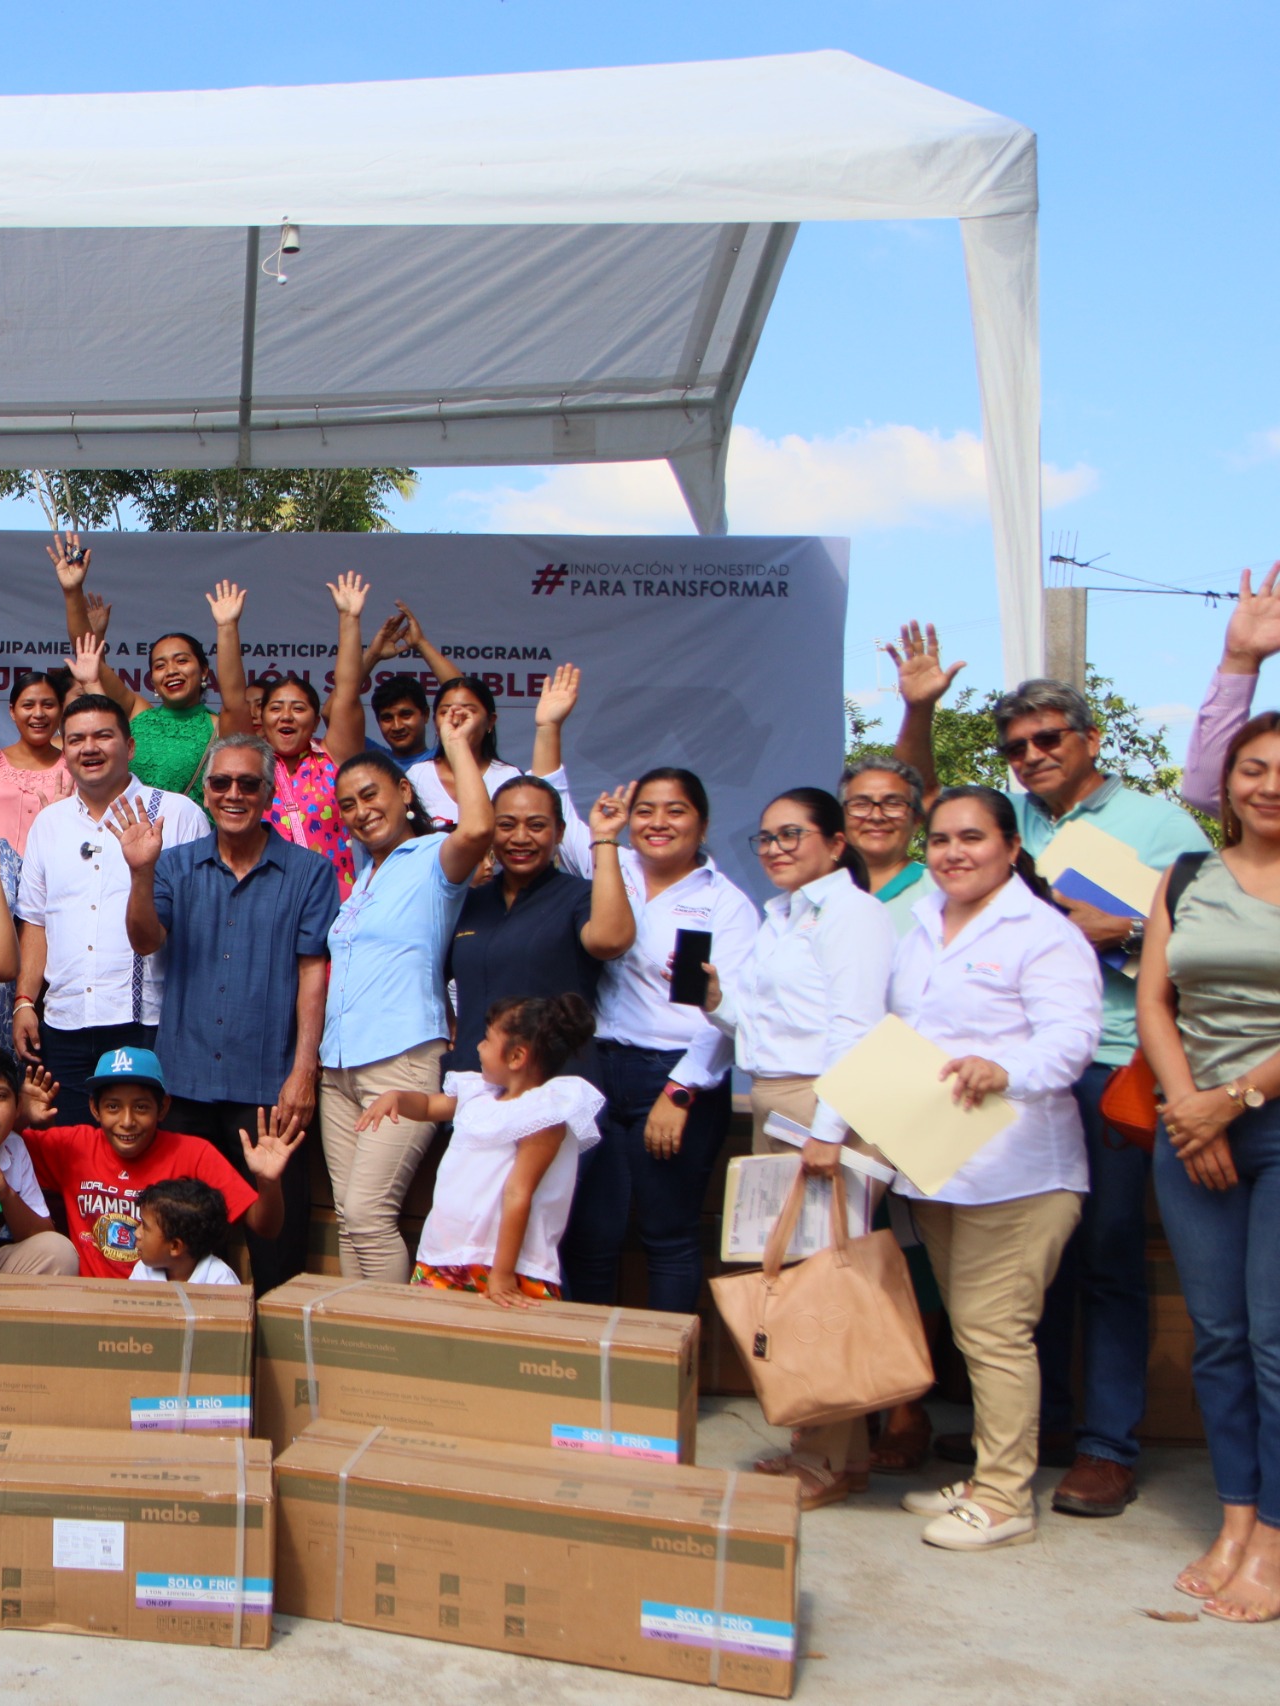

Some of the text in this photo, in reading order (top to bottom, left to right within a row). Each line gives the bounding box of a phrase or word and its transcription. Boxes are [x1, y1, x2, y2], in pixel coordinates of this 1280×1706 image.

[571, 561, 790, 576] INNOVACIÓN Y HONESTIDAD
[571, 580, 789, 597] PARA TRANSFORMAR
[116, 642, 130, 655] A
[441, 646, 552, 660] PROGRAMA
[111, 1050, 132, 1072] LA
[80, 1181, 118, 1194] WORLD
[98, 1336, 154, 1355] mabe
[519, 1360, 577, 1381] mabe
[196, 1397, 222, 1409] FRÍO
[557, 1439, 584, 1448] ON-OFF
[622, 1434, 651, 1449] FRÍO
[110, 1472, 201, 1482] mabe
[141, 1504, 200, 1523] mabe
[651, 1535, 715, 1557] mabe
[168, 1578, 238, 1591] SOLO FRÍO
[146, 1600, 172, 1608] ON-OFF
[675, 1609, 753, 1631] SOLO FRÍO
[650, 1630, 679, 1641] ON-OFF
